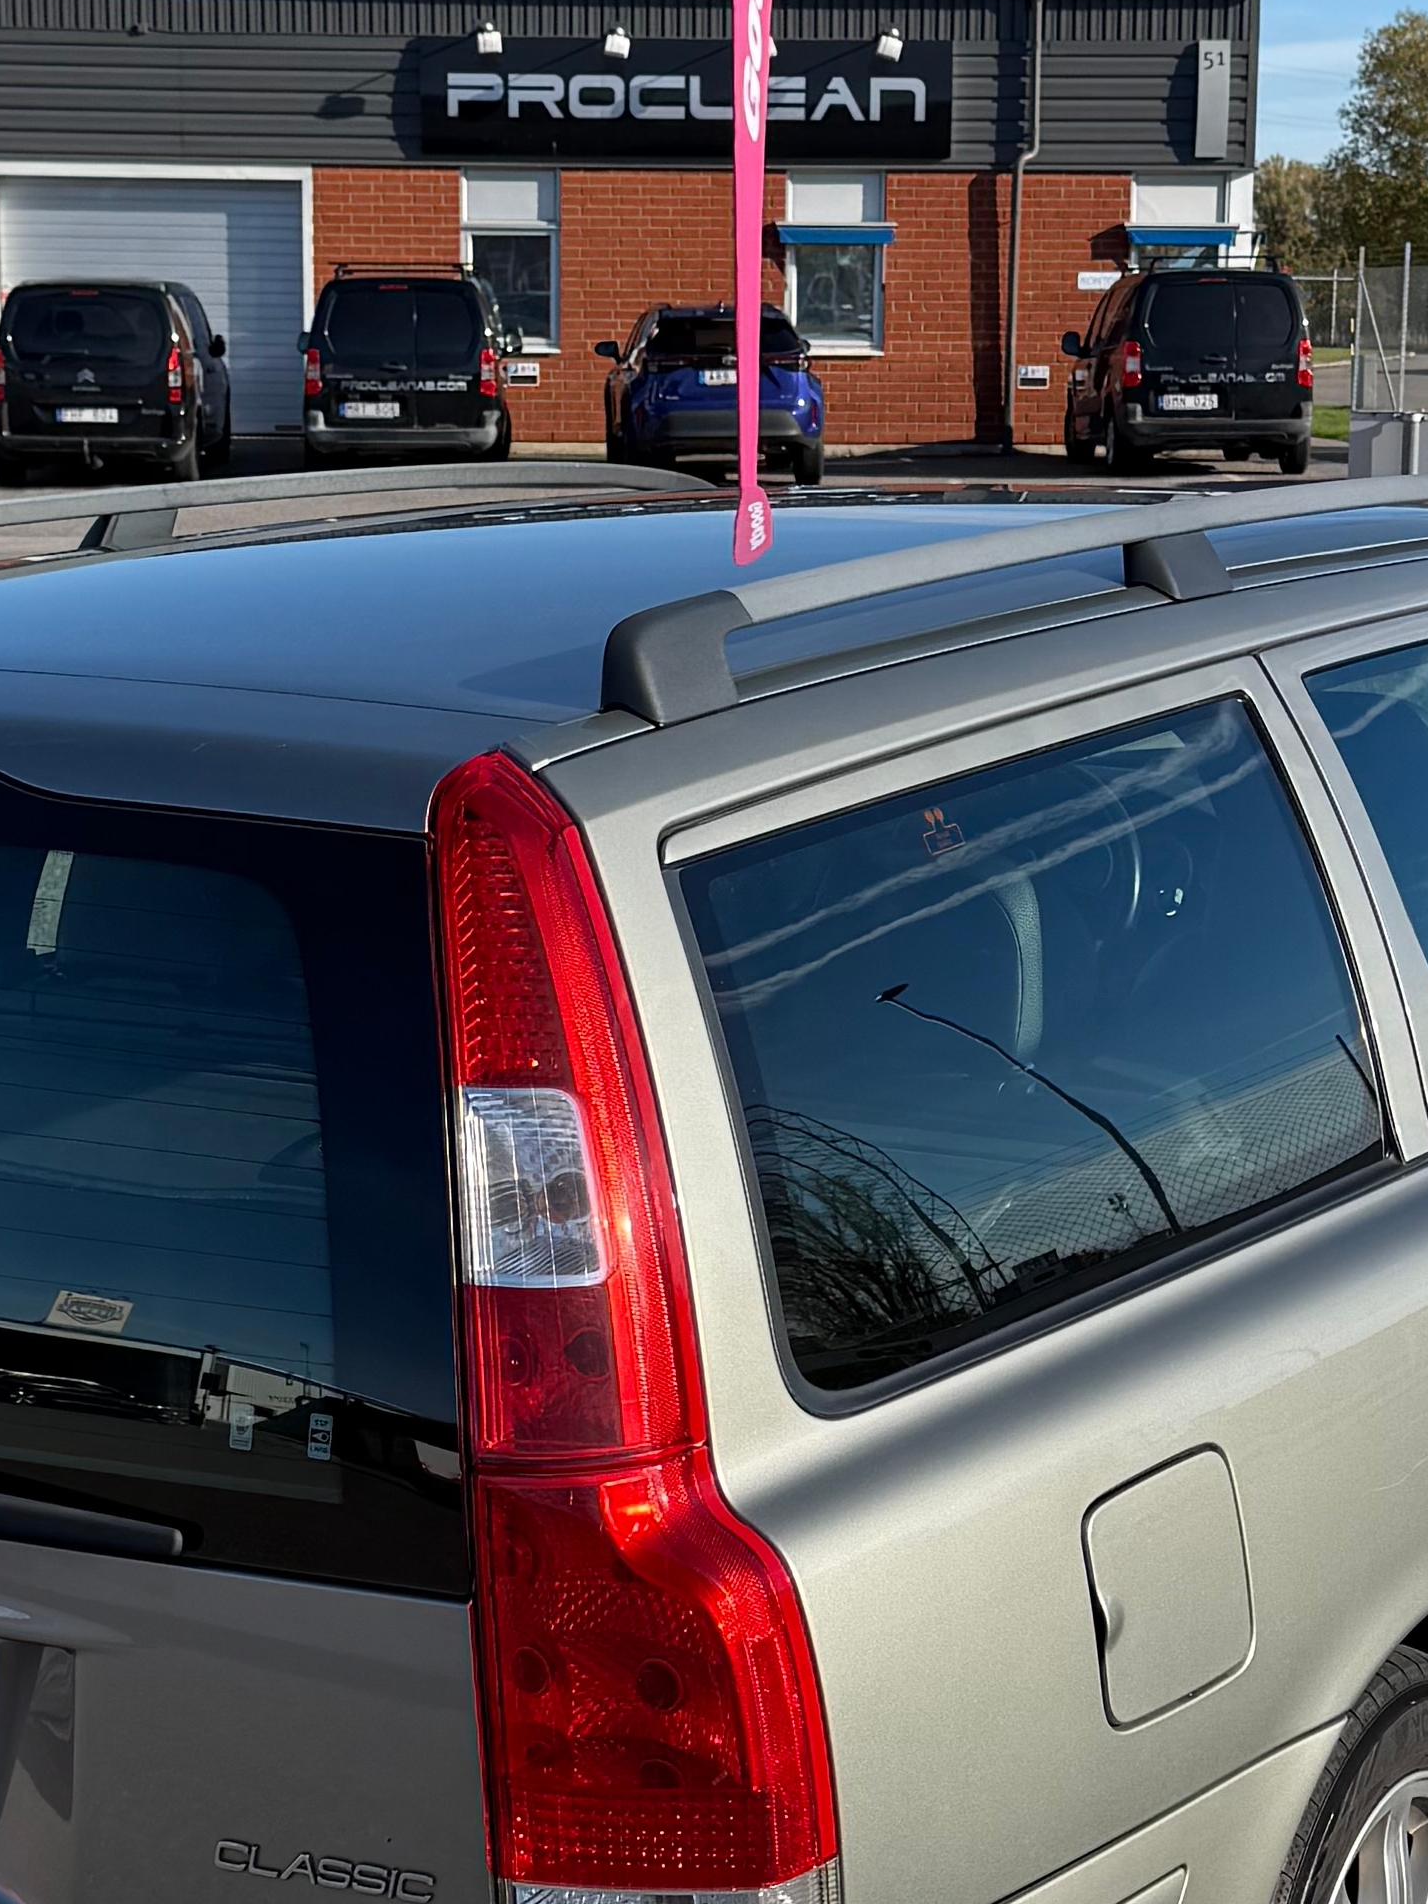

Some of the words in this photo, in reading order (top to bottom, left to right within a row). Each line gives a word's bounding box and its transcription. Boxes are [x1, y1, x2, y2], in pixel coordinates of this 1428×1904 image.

[1203, 51, 1225, 71] 51
[447, 72, 926, 122] PROCLEAN
[214, 1840, 435, 1904] CLASSIC
